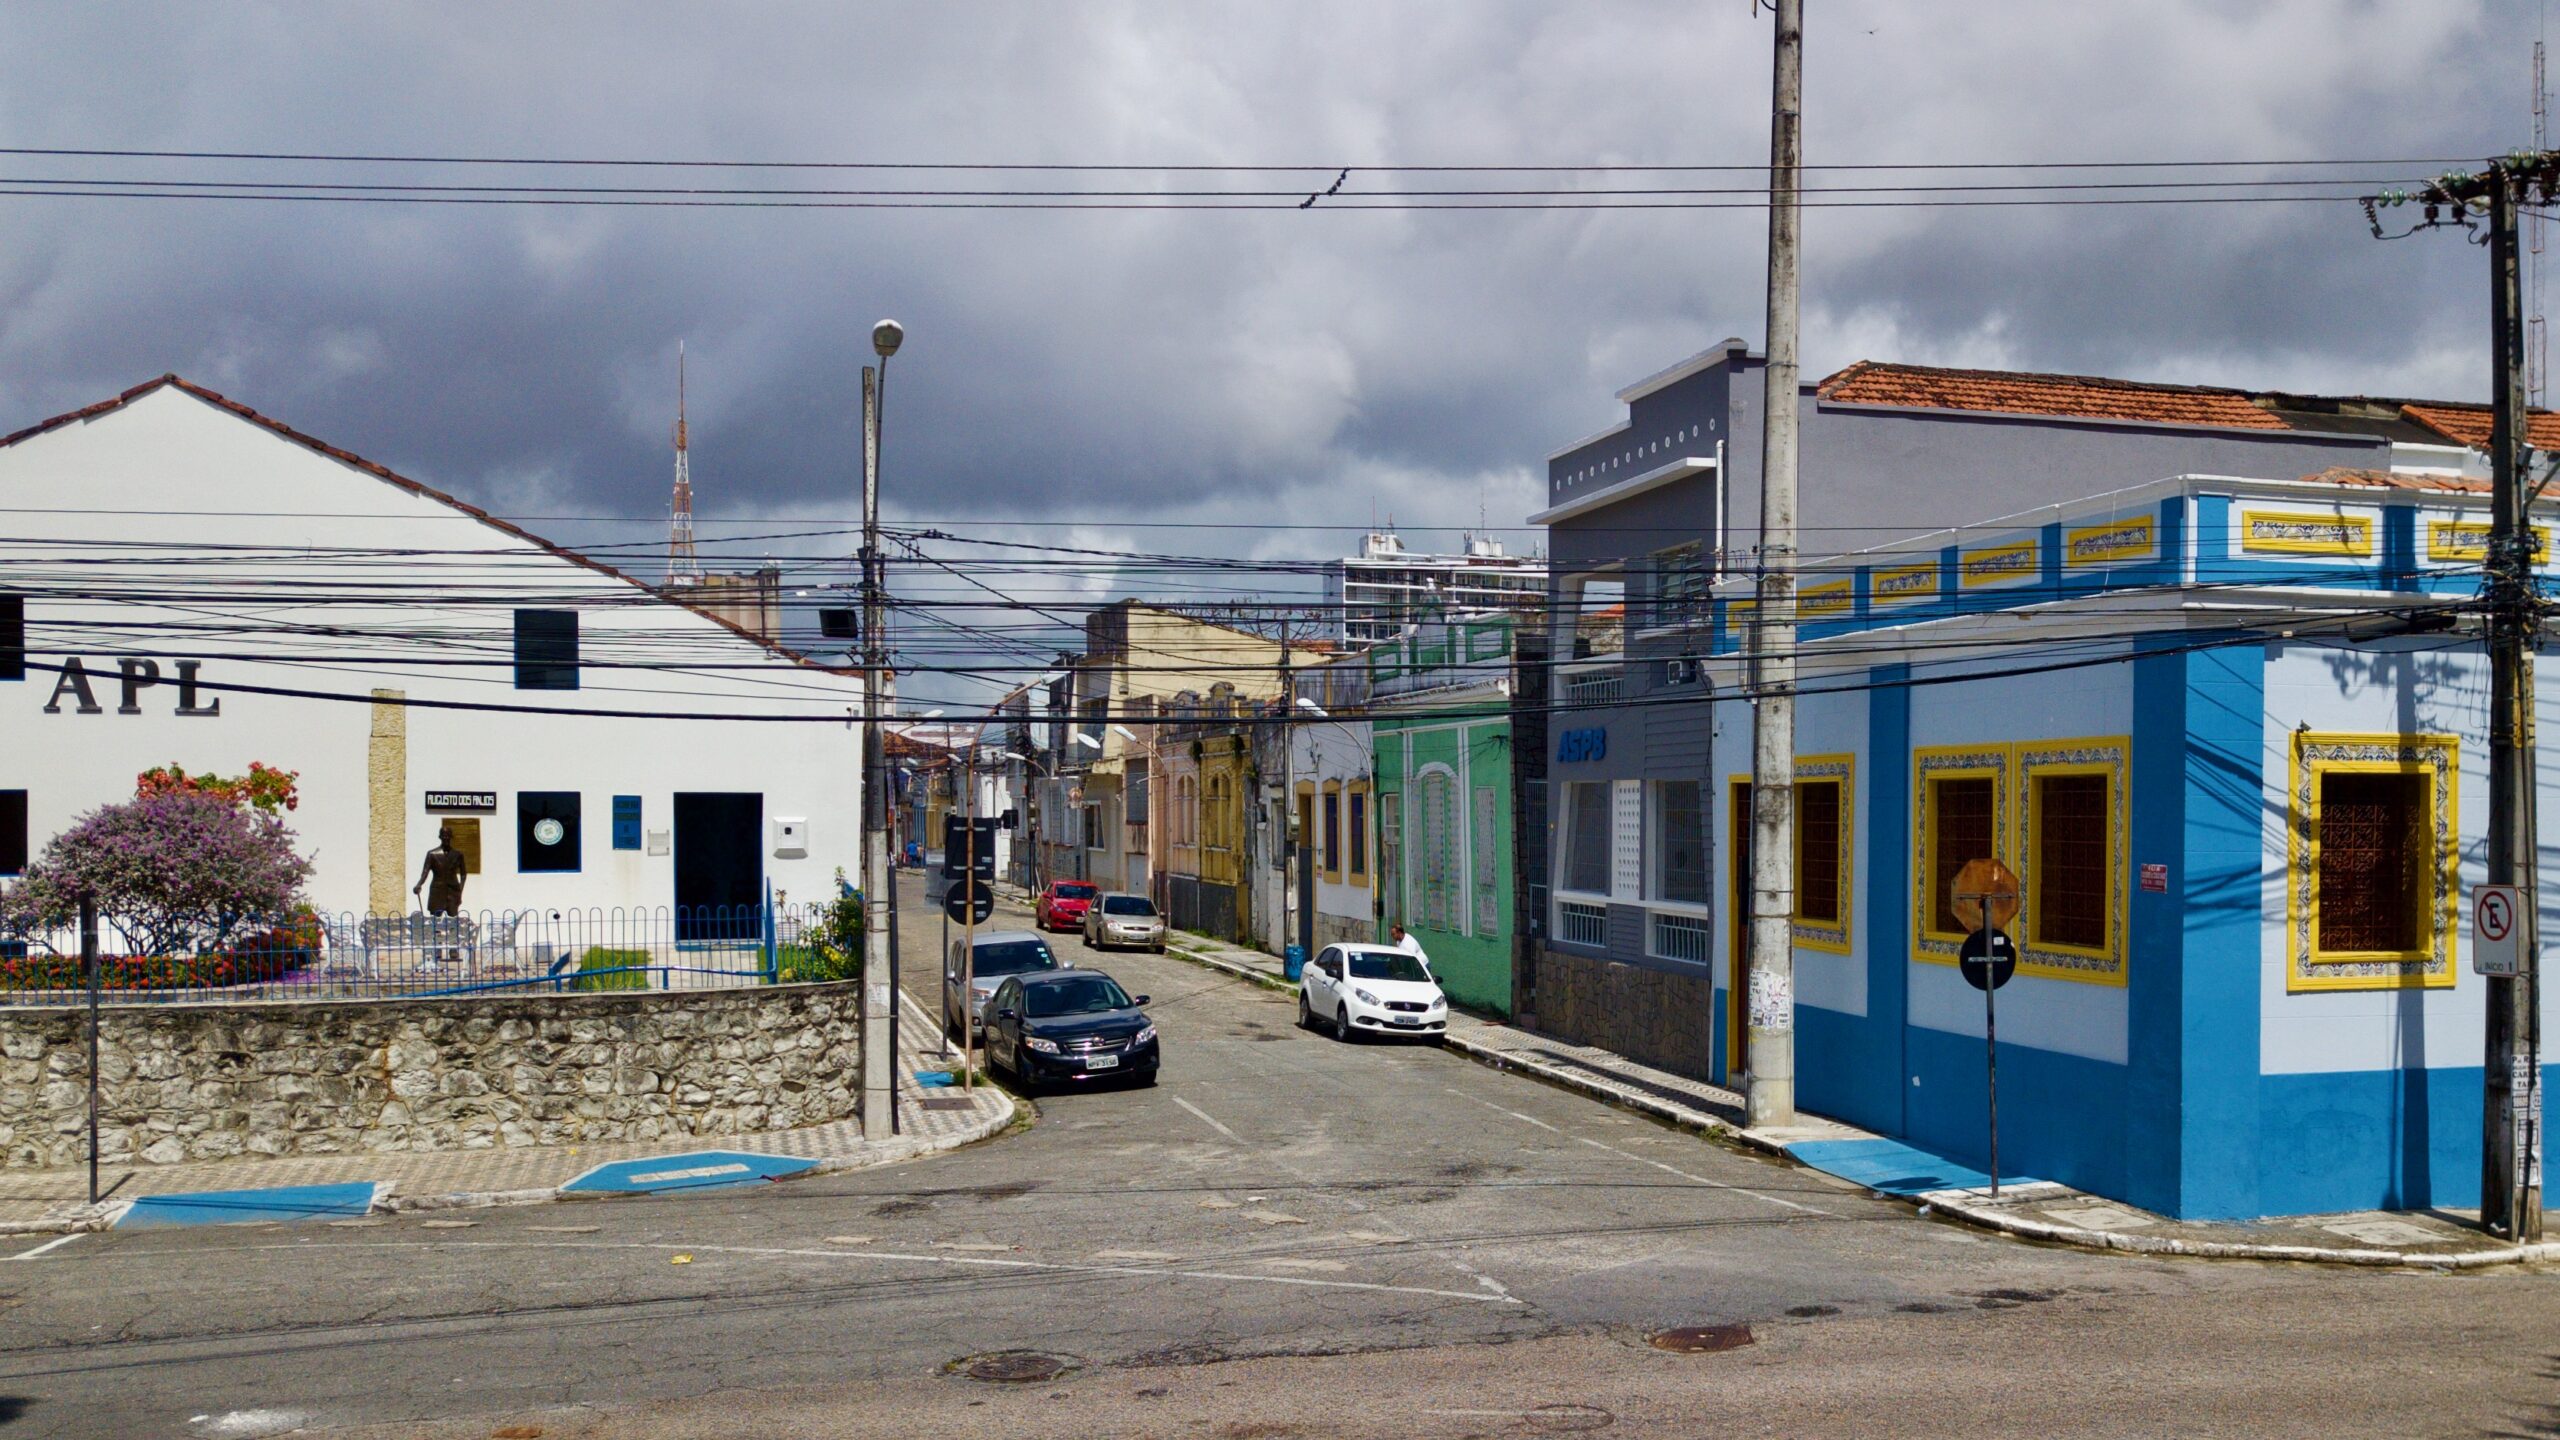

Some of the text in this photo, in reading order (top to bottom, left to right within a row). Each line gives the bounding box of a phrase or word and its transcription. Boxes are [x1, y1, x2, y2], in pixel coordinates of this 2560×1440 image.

[43, 656, 221, 717] APL
[1557, 728, 1607, 763] ASPB
[427, 794, 495, 806] AUGUSTO DOS ANJOS
